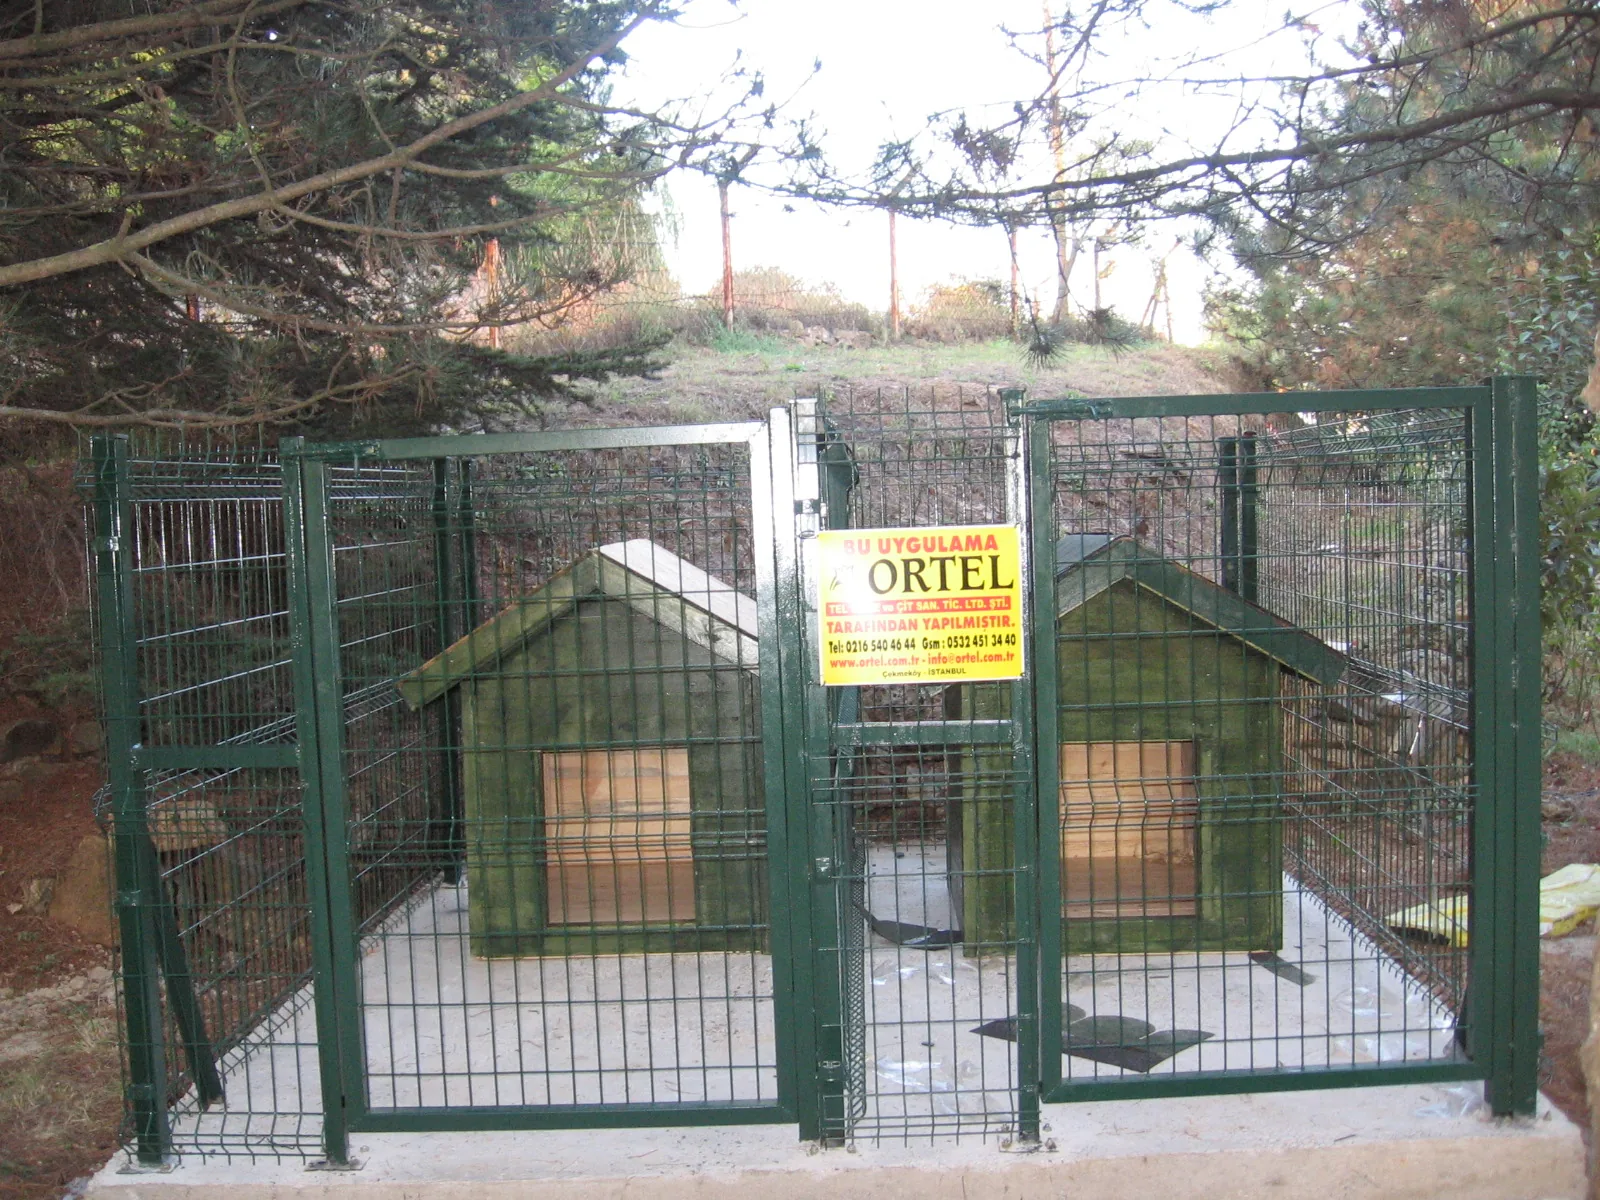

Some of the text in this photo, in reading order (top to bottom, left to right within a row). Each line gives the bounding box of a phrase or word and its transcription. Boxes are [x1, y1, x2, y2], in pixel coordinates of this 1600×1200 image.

[844, 534, 998, 555] BU UYGULAMA
[868, 554, 1014, 594] ORTEL
[829, 604, 848, 614] TEL
[897, 600, 914, 613] ÇİT
[916, 601, 939, 611] SAN.
[943, 598, 962, 610] TİC.
[965, 599, 987, 609] LTD.
[989, 597, 1008, 610] ŞTİ.
[827, 615, 1015, 634] TARAFINDAN YAPILMIŞTIR.
[829, 640, 844, 653] Tel:
[846, 639, 868, 652] 0216
[871, 639, 888, 652] 540
[890, 638, 901, 650] 46
[904, 638, 916, 650] 44
[947, 636, 970, 648] 0532
[972, 635, 988, 647] 451
[991, 634, 1002, 646] 34
[1004, 633, 1016, 645] 40
[830, 654, 919, 668] www.ortel.com.tr
[928, 651, 1015, 665] info@ortel.com.tr
